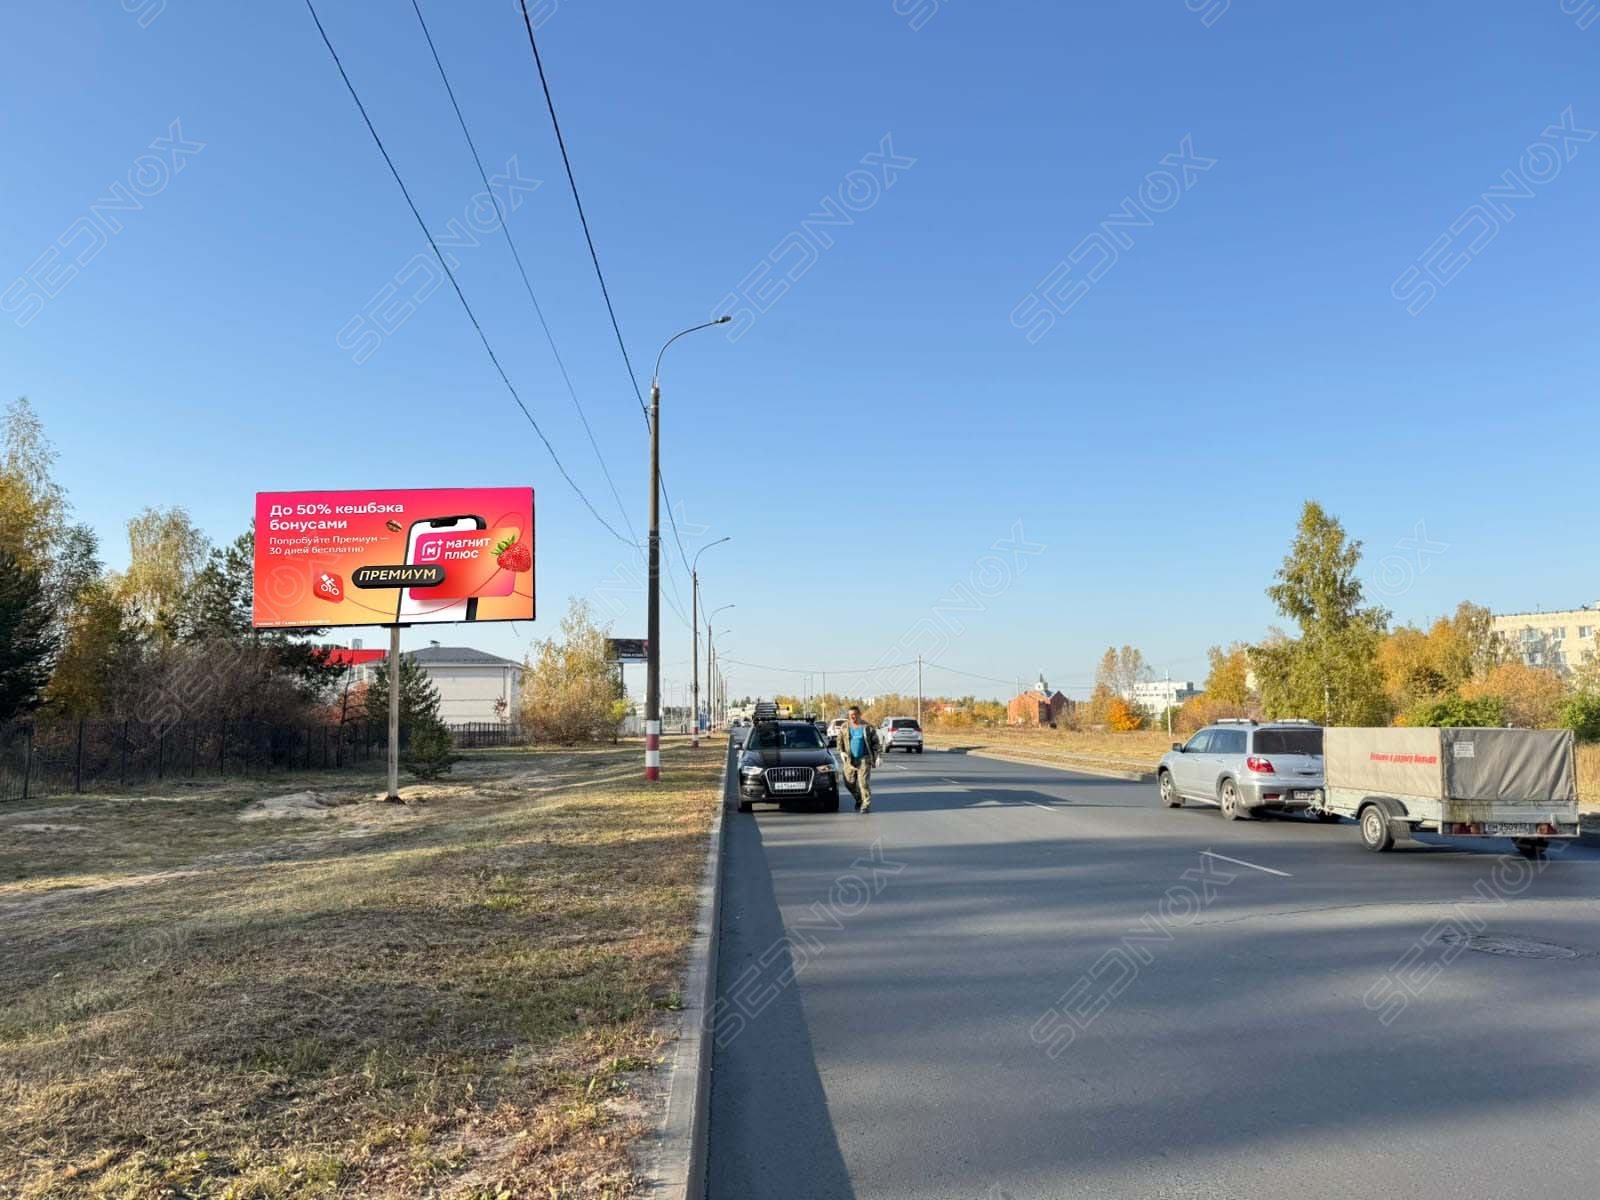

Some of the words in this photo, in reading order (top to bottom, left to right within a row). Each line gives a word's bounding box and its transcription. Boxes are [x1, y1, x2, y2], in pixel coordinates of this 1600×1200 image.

[269, 505, 293, 517] До
[297, 504, 332, 515] 50%
[335, 502, 404, 514] кешбэка
[269, 518, 348, 532] бонусами
[269, 535, 330, 546] Попробуйте
[332, 535, 378, 545] Премиум
[269, 547, 282, 555] 30
[284, 545, 309, 556] дней
[311, 545, 365, 554] бесплатно
[360, 568, 437, 580] ПРЕМИУМ
